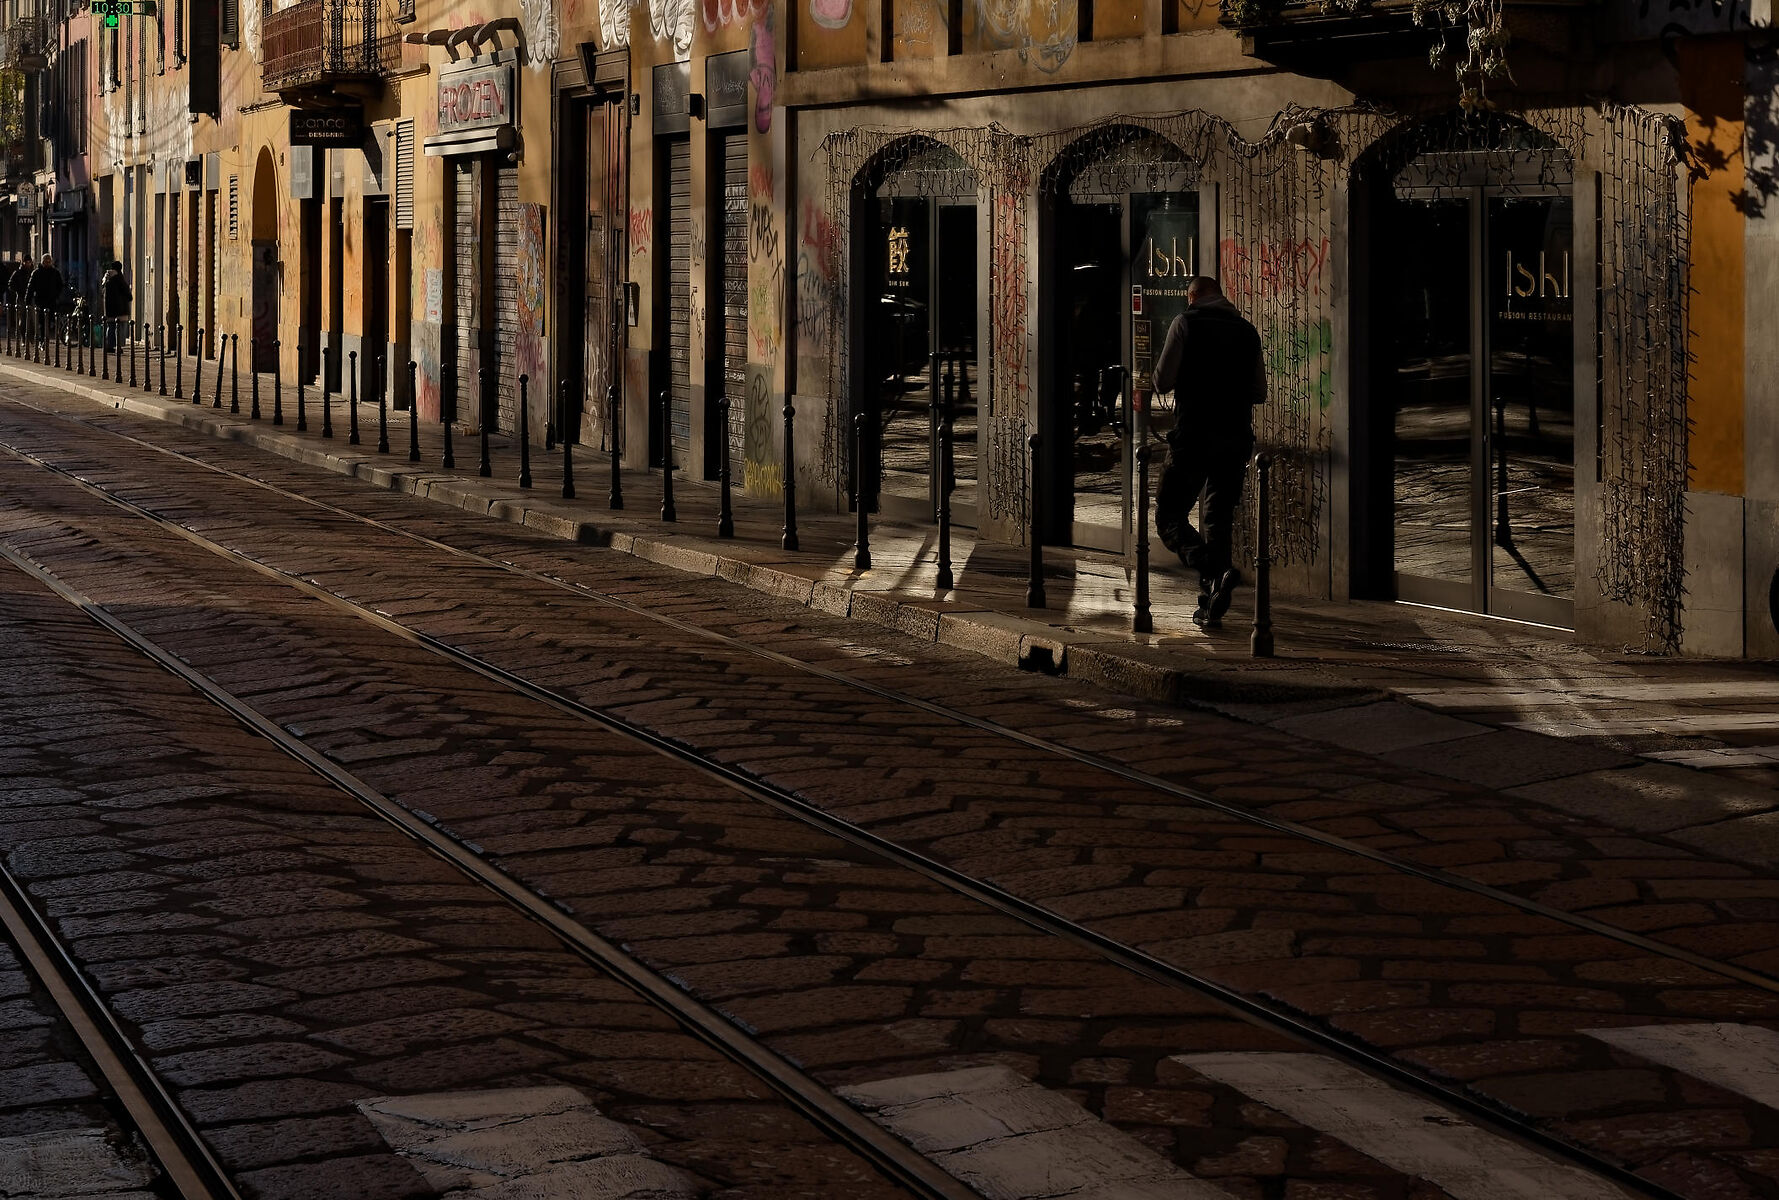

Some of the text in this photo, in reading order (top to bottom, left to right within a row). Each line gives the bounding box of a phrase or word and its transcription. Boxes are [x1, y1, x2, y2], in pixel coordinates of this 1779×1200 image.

[94, 3, 130, 14] 10:30
[438, 79, 505, 124] FROZEN
[1142, 288, 1188, 297] FUSION RESTAUR
[1497, 311, 1573, 321] FUSION RESTAURAN
